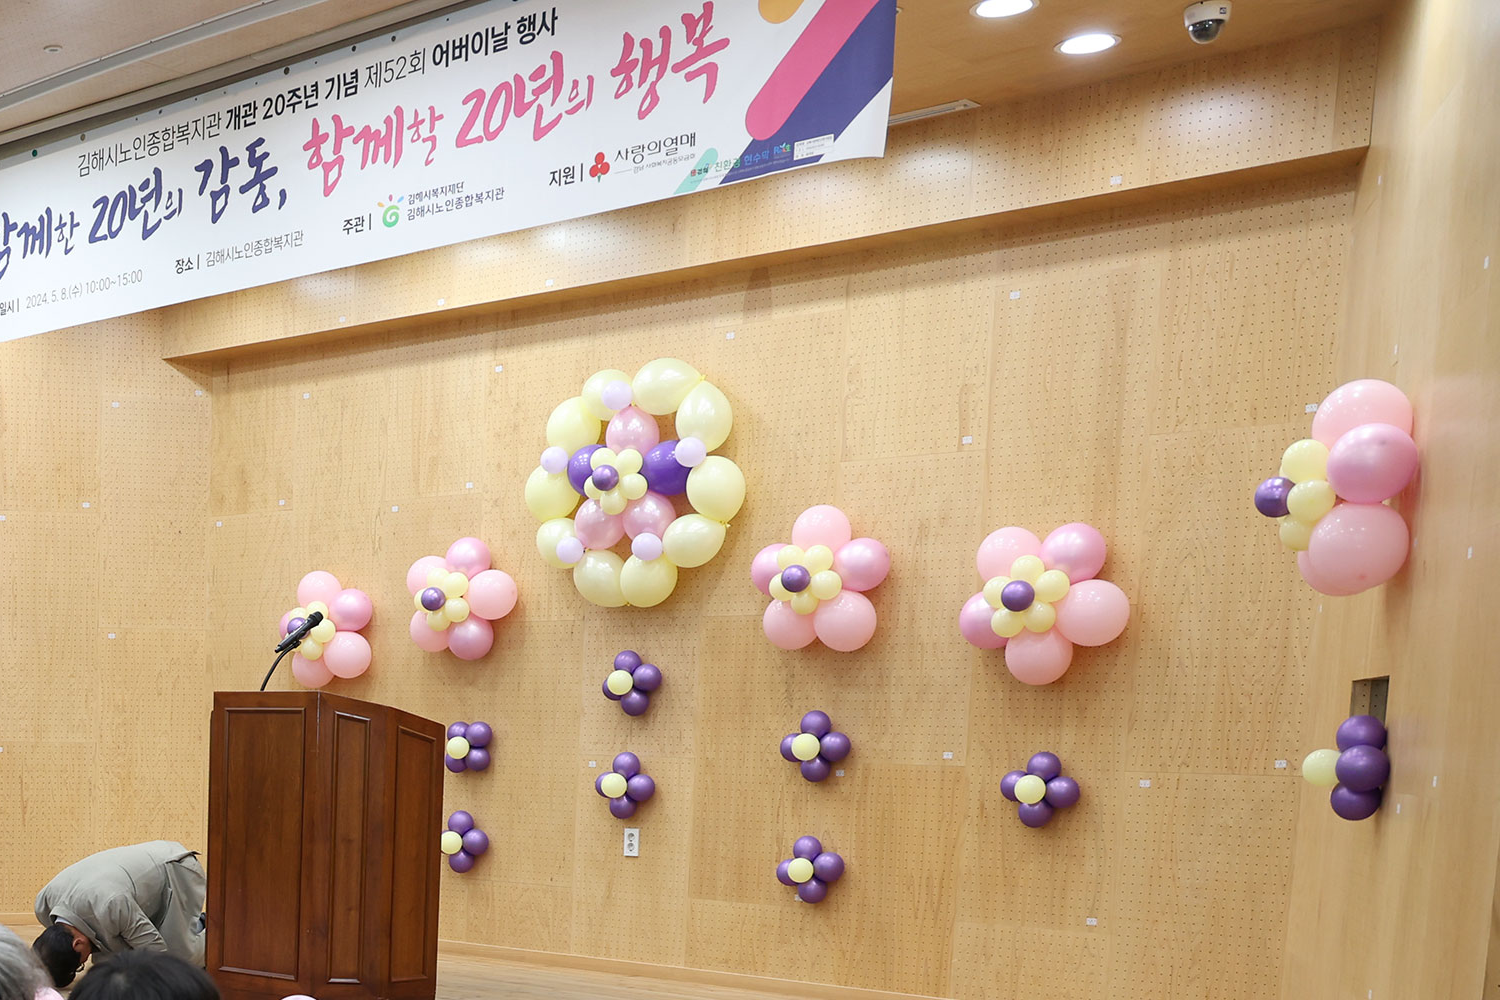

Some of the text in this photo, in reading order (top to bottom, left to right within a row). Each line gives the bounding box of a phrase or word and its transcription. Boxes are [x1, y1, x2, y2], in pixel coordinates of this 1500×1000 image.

[77, 7, 559, 177] 김해시노인종합복지관 개관 20주년 기념 제52회 어버이날 행사
[88, 167, 183, 244] 20년의
[194, 136, 288, 224] 감동,
[302, 105, 444, 197] 함께할
[455, 50, 595, 149] 20년의
[610, 1, 731, 120] 행복
[614, 132, 696, 165] 사랑의열매
[407, 181, 465, 205] 김해시복지재단
[549, 165, 575, 187] 지원
[406, 187, 505, 221] 김해시노인종합복지관
[342, 215, 365, 235] 주관
[175, 230, 304, 275] 장소 김해시노인종합복지관
[0, 299, 15, 316] 일시
[26, 293, 50, 309] 2024.
[86, 269, 143, 294] 10:00~15:00
